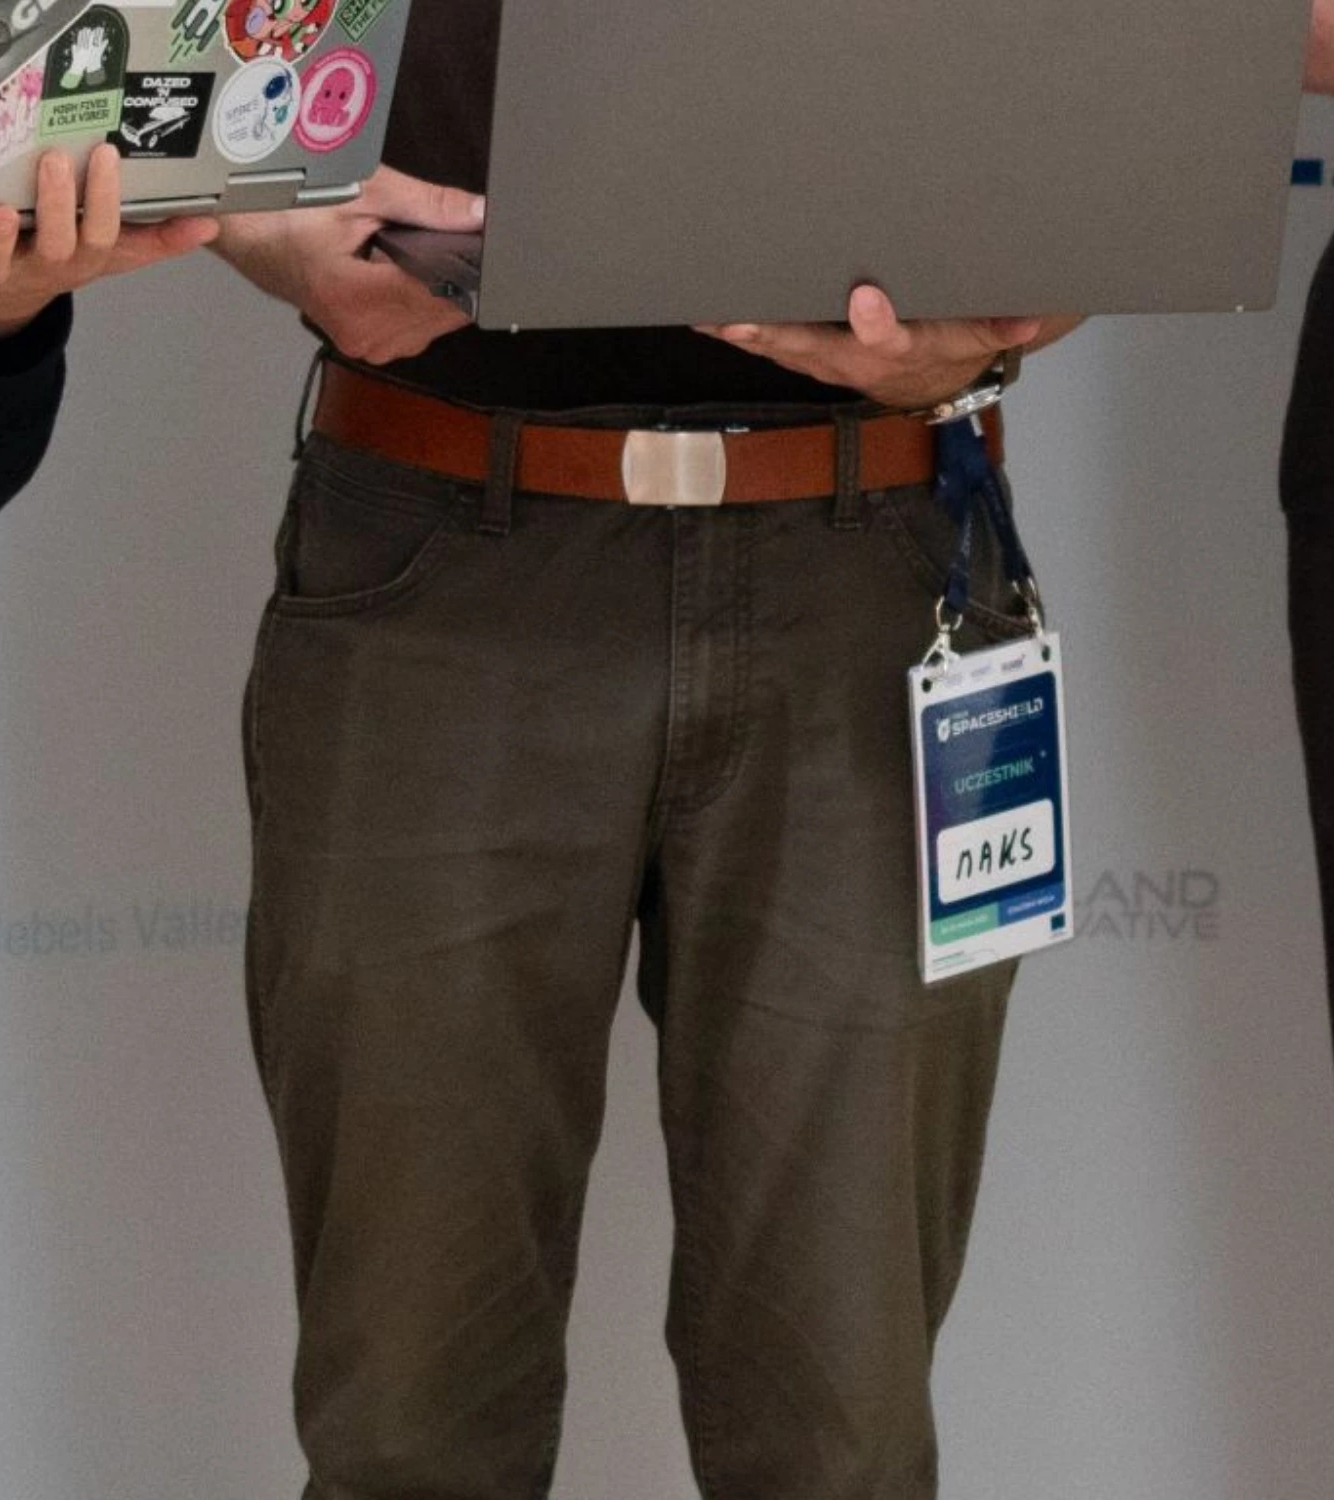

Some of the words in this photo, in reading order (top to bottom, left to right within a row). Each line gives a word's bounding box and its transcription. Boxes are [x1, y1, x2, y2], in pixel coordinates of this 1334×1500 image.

[142, 77, 191, 88] DAZED
[124, 96, 198, 108] CONFUSED
[952, 698, 1044, 736] SPACESHIELD
[954, 756, 1035, 794] UCZESTNIK
[1075, 867, 1220, 911] AND
[134, 894, 251, 950] Valle
